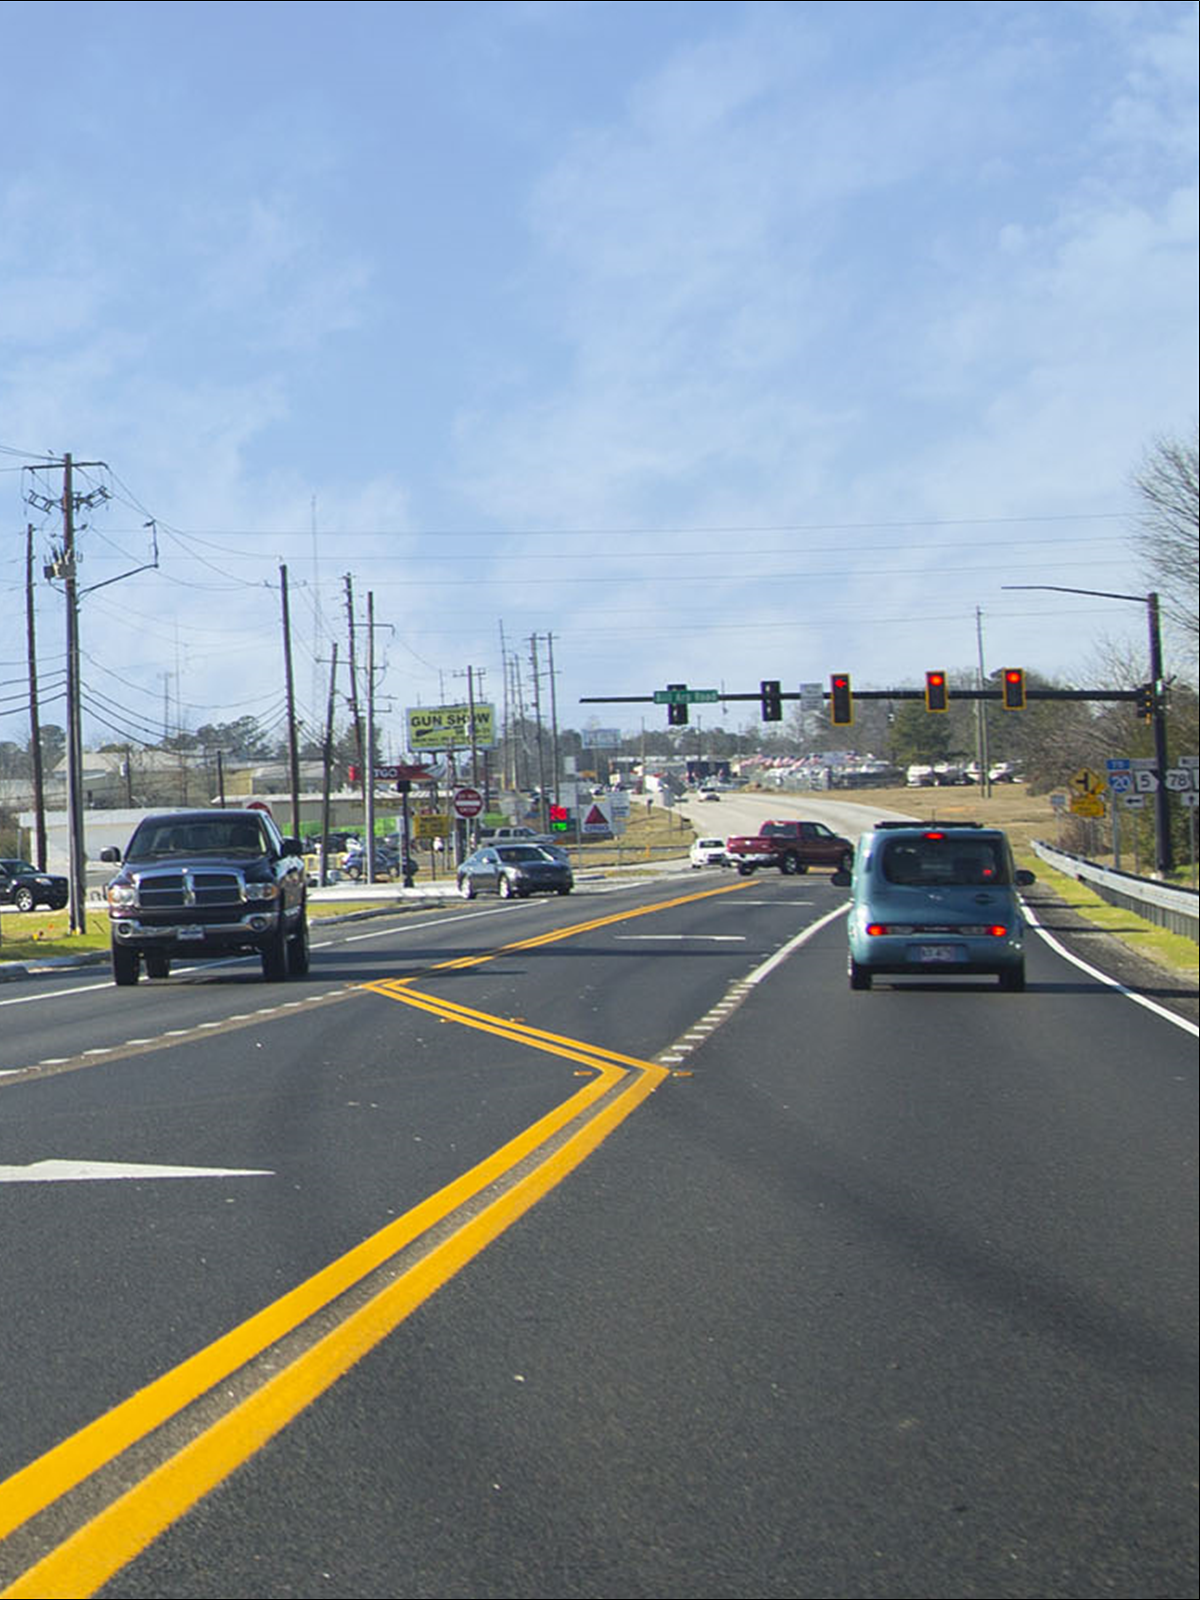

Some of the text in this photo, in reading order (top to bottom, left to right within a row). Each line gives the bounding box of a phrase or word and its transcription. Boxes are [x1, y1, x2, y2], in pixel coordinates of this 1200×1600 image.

[411, 713, 490, 727] GUN SHW
[1113, 776, 1129, 788] 20
[1140, 775, 1151, 787] 5
[1169, 774, 1187, 786] 78
